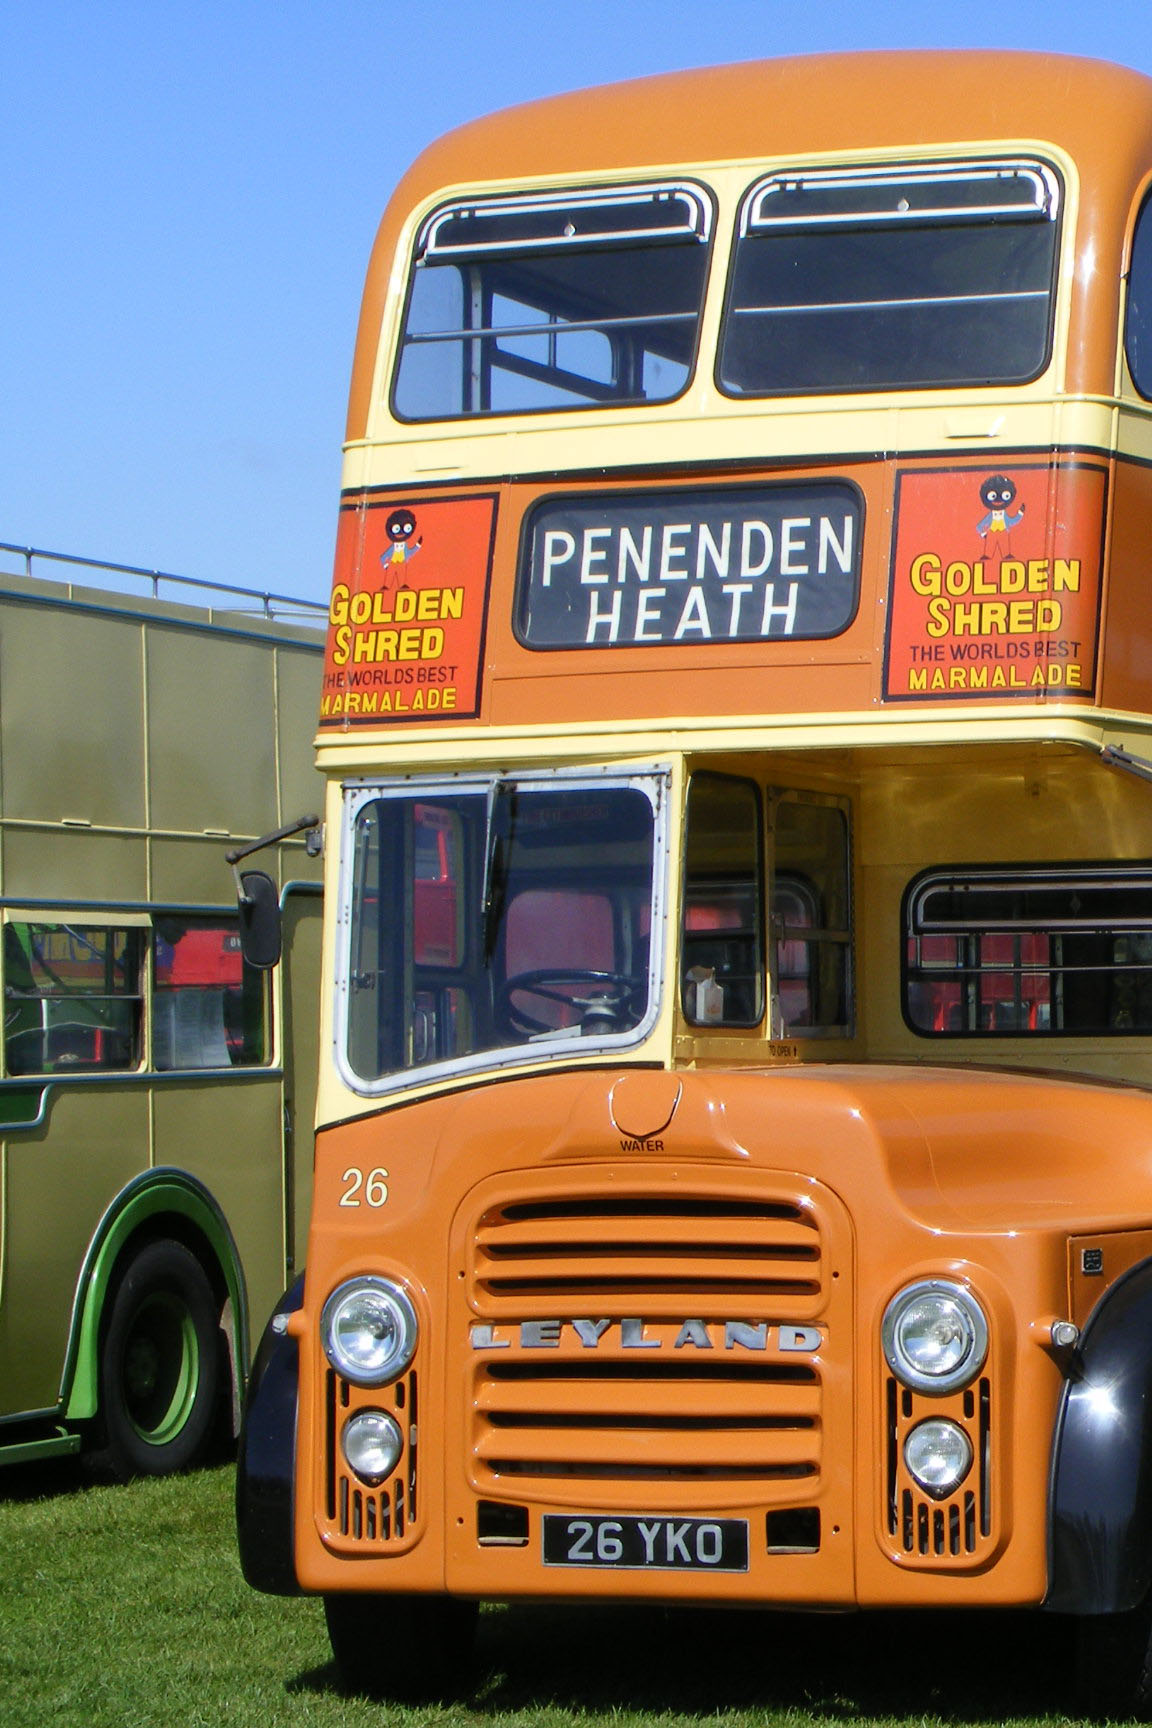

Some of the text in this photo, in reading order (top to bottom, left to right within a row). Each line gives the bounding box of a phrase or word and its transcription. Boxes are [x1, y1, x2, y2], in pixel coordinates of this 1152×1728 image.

[543, 515, 853, 587] PENENDEN
[909, 552, 1081, 596] GOLDEN
[329, 583, 464, 626] GOLDEN
[585, 582, 798, 643] HEATH
[926, 597, 1062, 638] SHRED
[333, 625, 445, 666] SHRED
[910, 640, 1081, 662] THE WORLDS BEST
[348, 668, 414, 687] WORLDS
[417, 666, 458, 683] BEST
[908, 664, 1082, 691] MARMALADE
[320, 687, 457, 716] MARMALADE
[620, 1140, 664, 1152] WATER
[339, 1167, 389, 1208] 26
[470, 1318, 823, 1352] LEYLAND
[567, 1521, 723, 1564] 26 YKO
